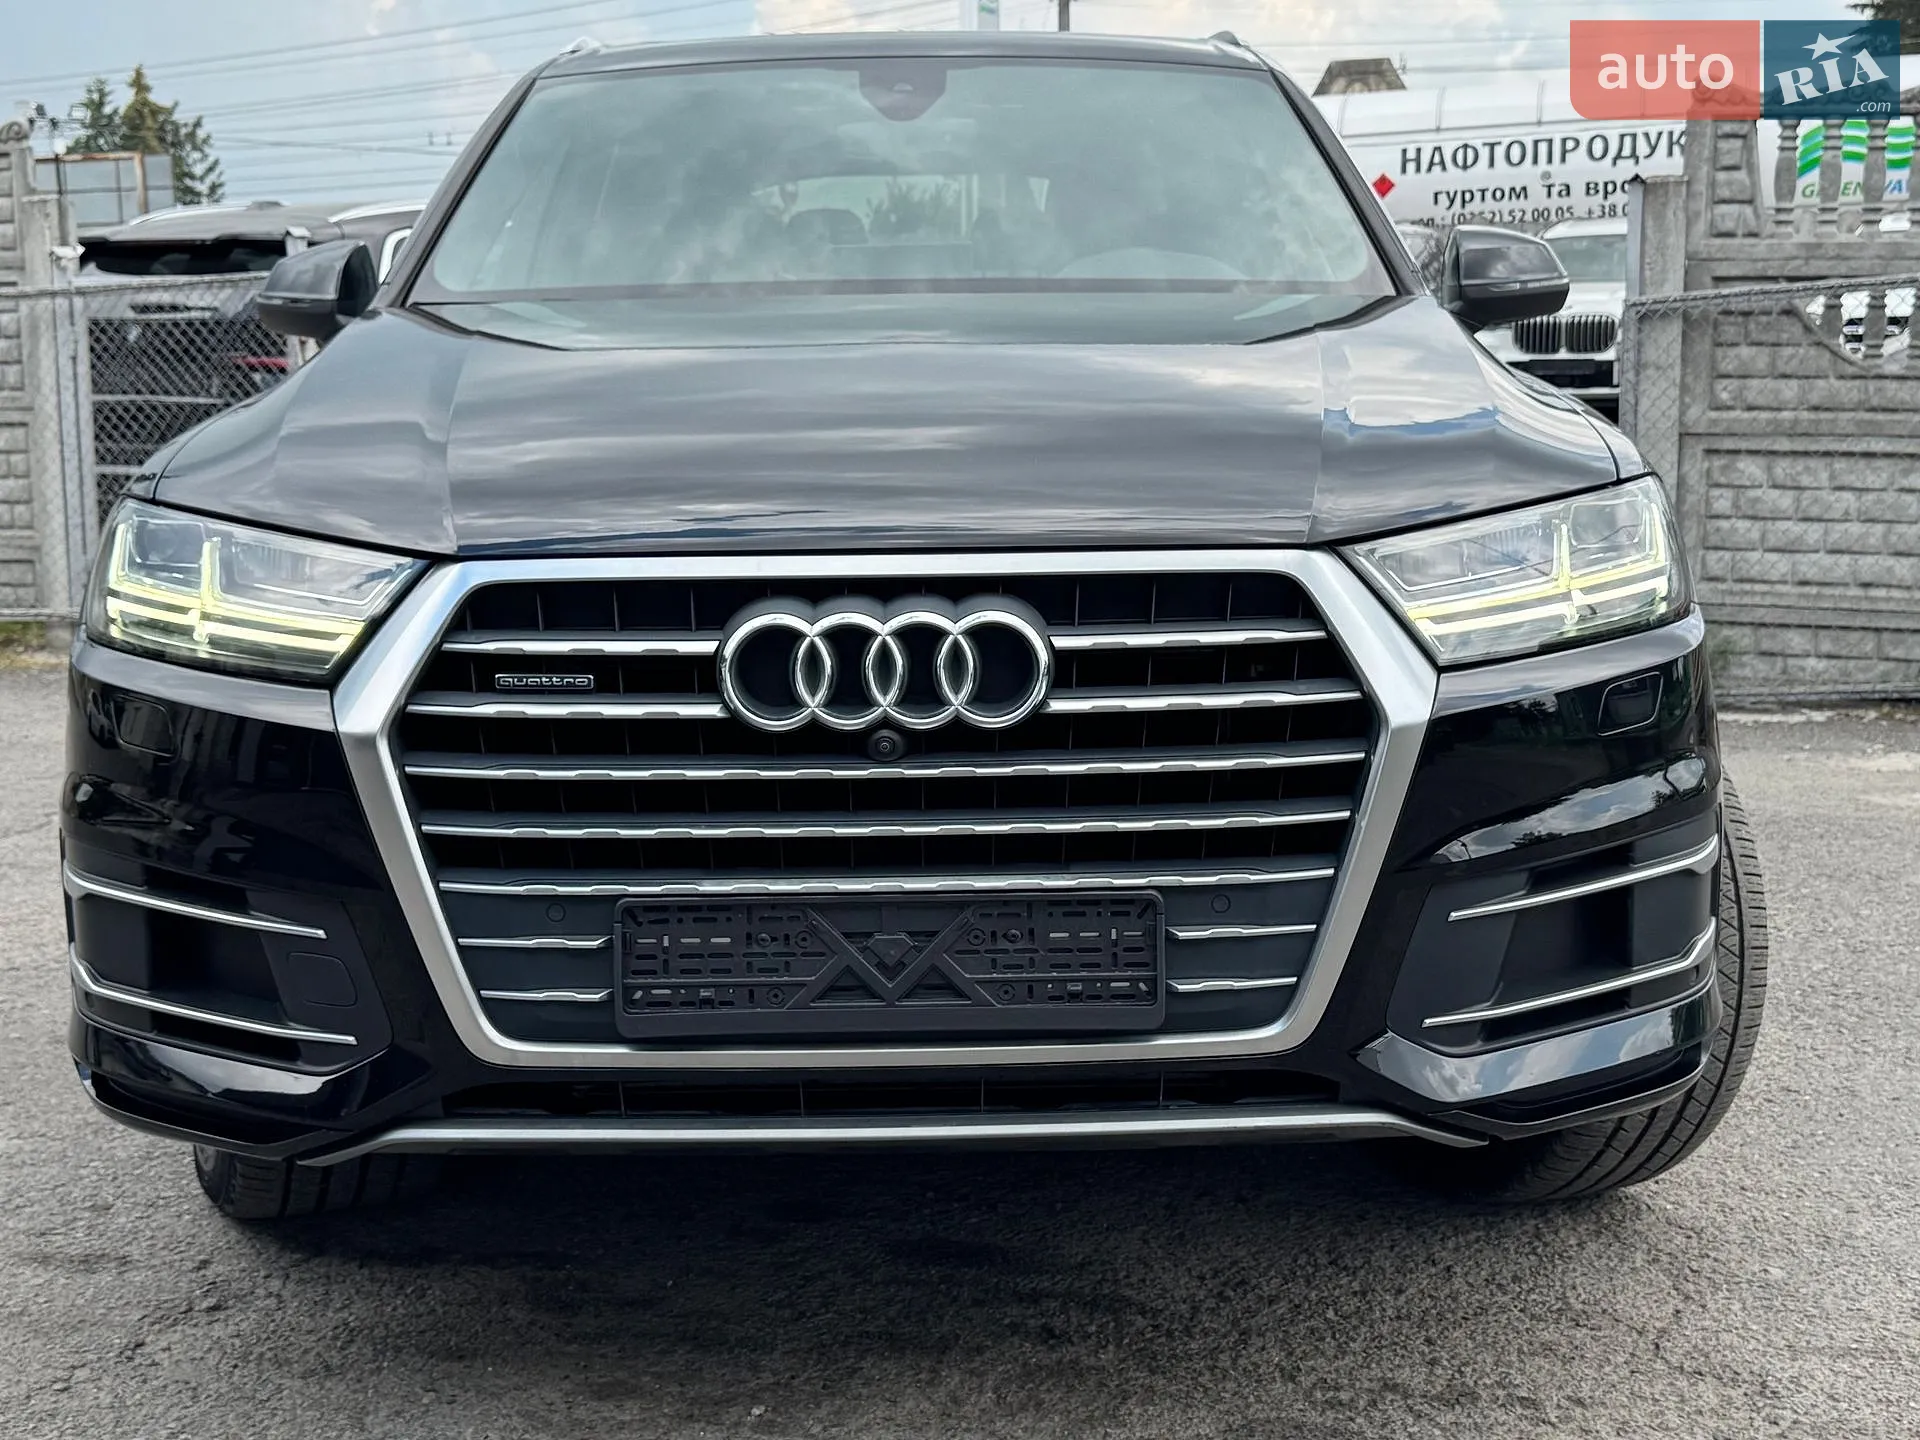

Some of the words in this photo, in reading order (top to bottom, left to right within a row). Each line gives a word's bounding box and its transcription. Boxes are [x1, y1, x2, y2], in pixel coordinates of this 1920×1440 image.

[1432, 183, 1529, 211] гуртом
[1543, 181, 1571, 200] та
[499, 677, 588, 687] quattro
